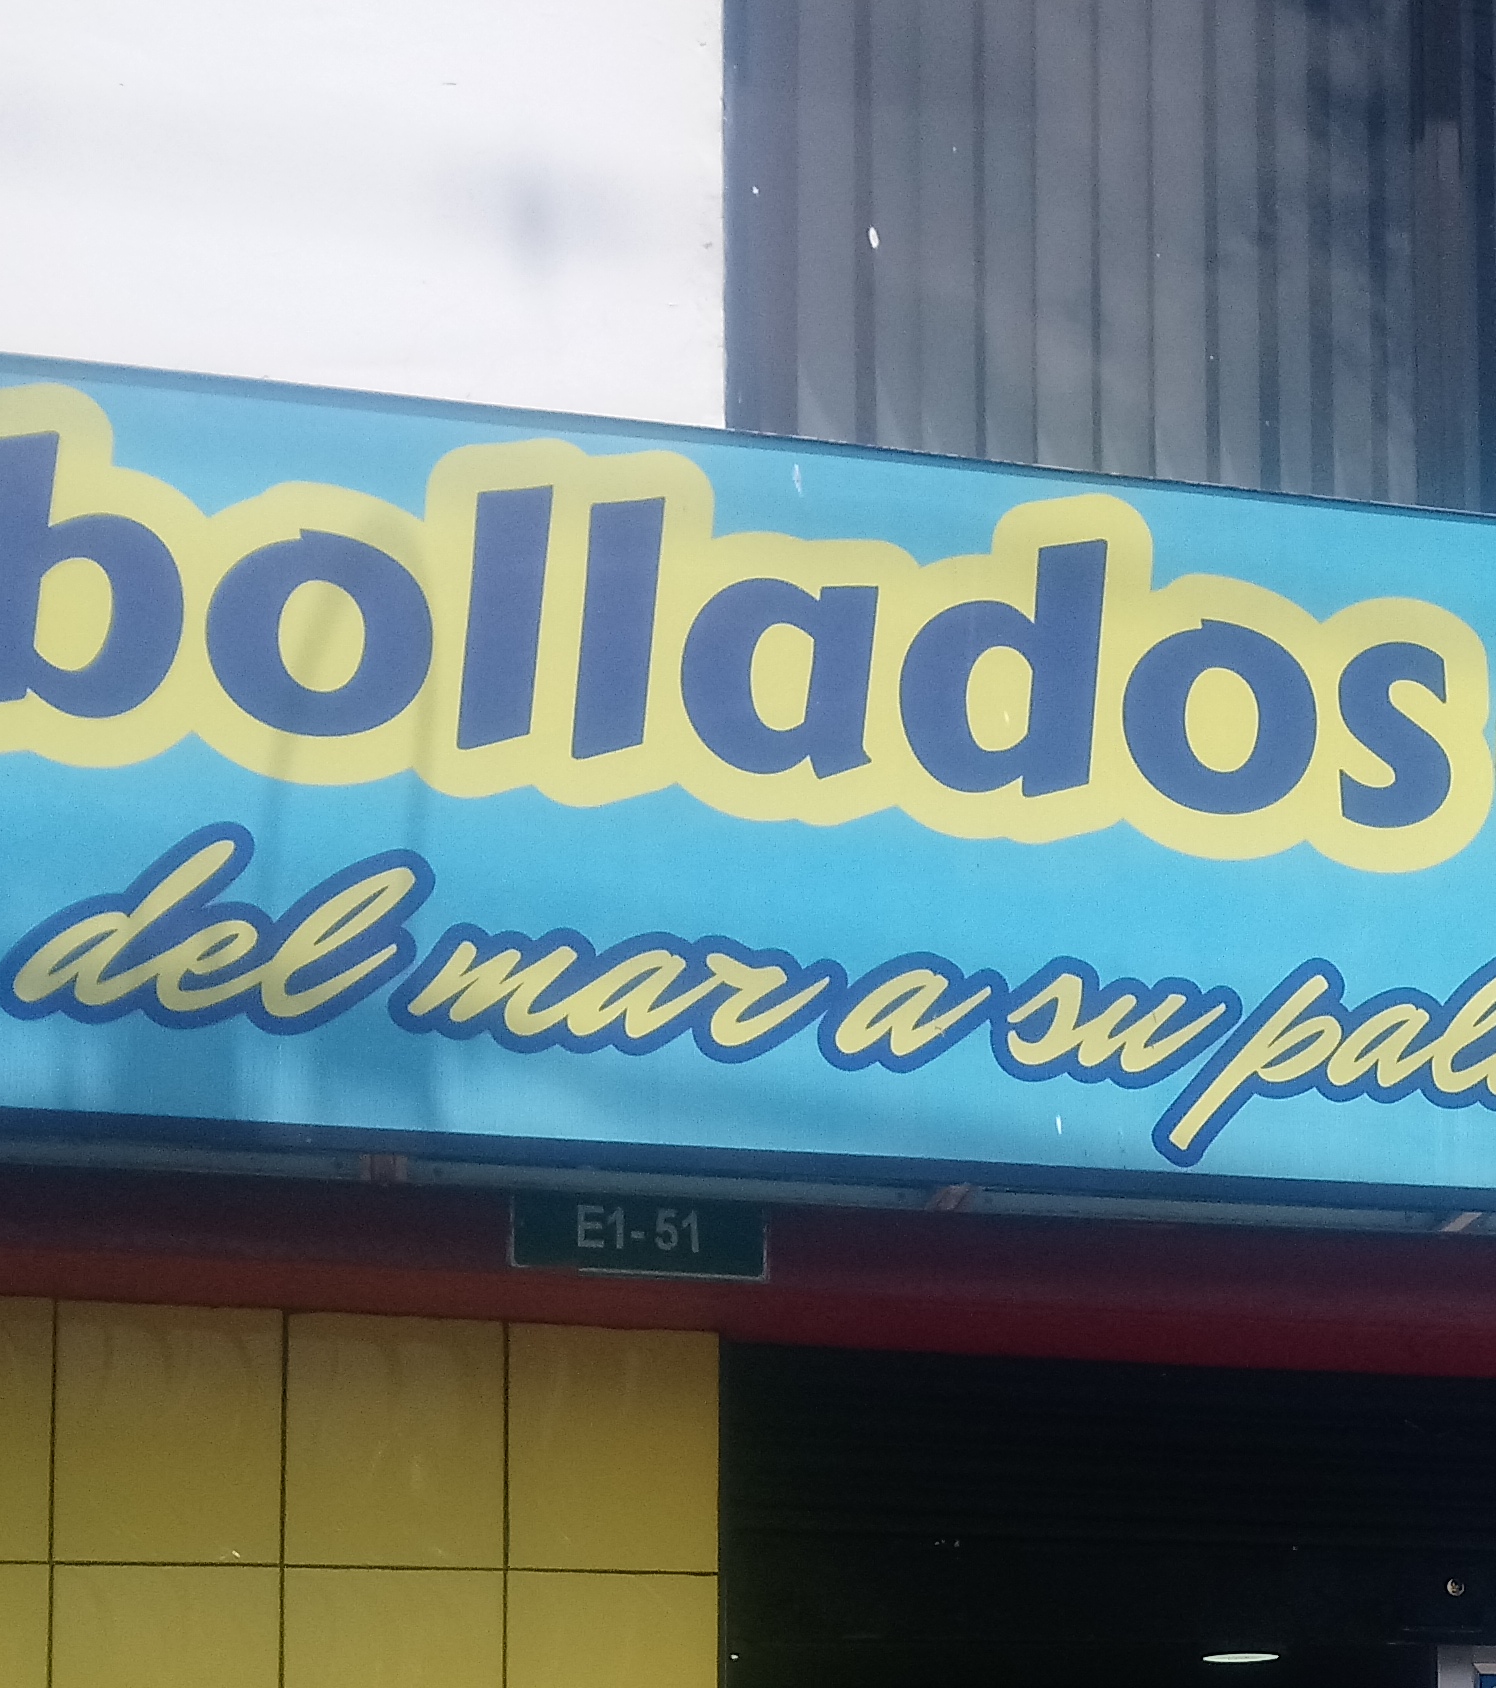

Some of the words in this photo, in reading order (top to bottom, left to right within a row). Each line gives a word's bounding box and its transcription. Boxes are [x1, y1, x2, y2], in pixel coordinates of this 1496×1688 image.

[7, 830, 421, 1024] del
[402, 932, 834, 1054] mar
[829, 962, 992, 1063] a
[1001, 966, 1232, 1078] su
[576, 1203, 701, 1253] E1-51
